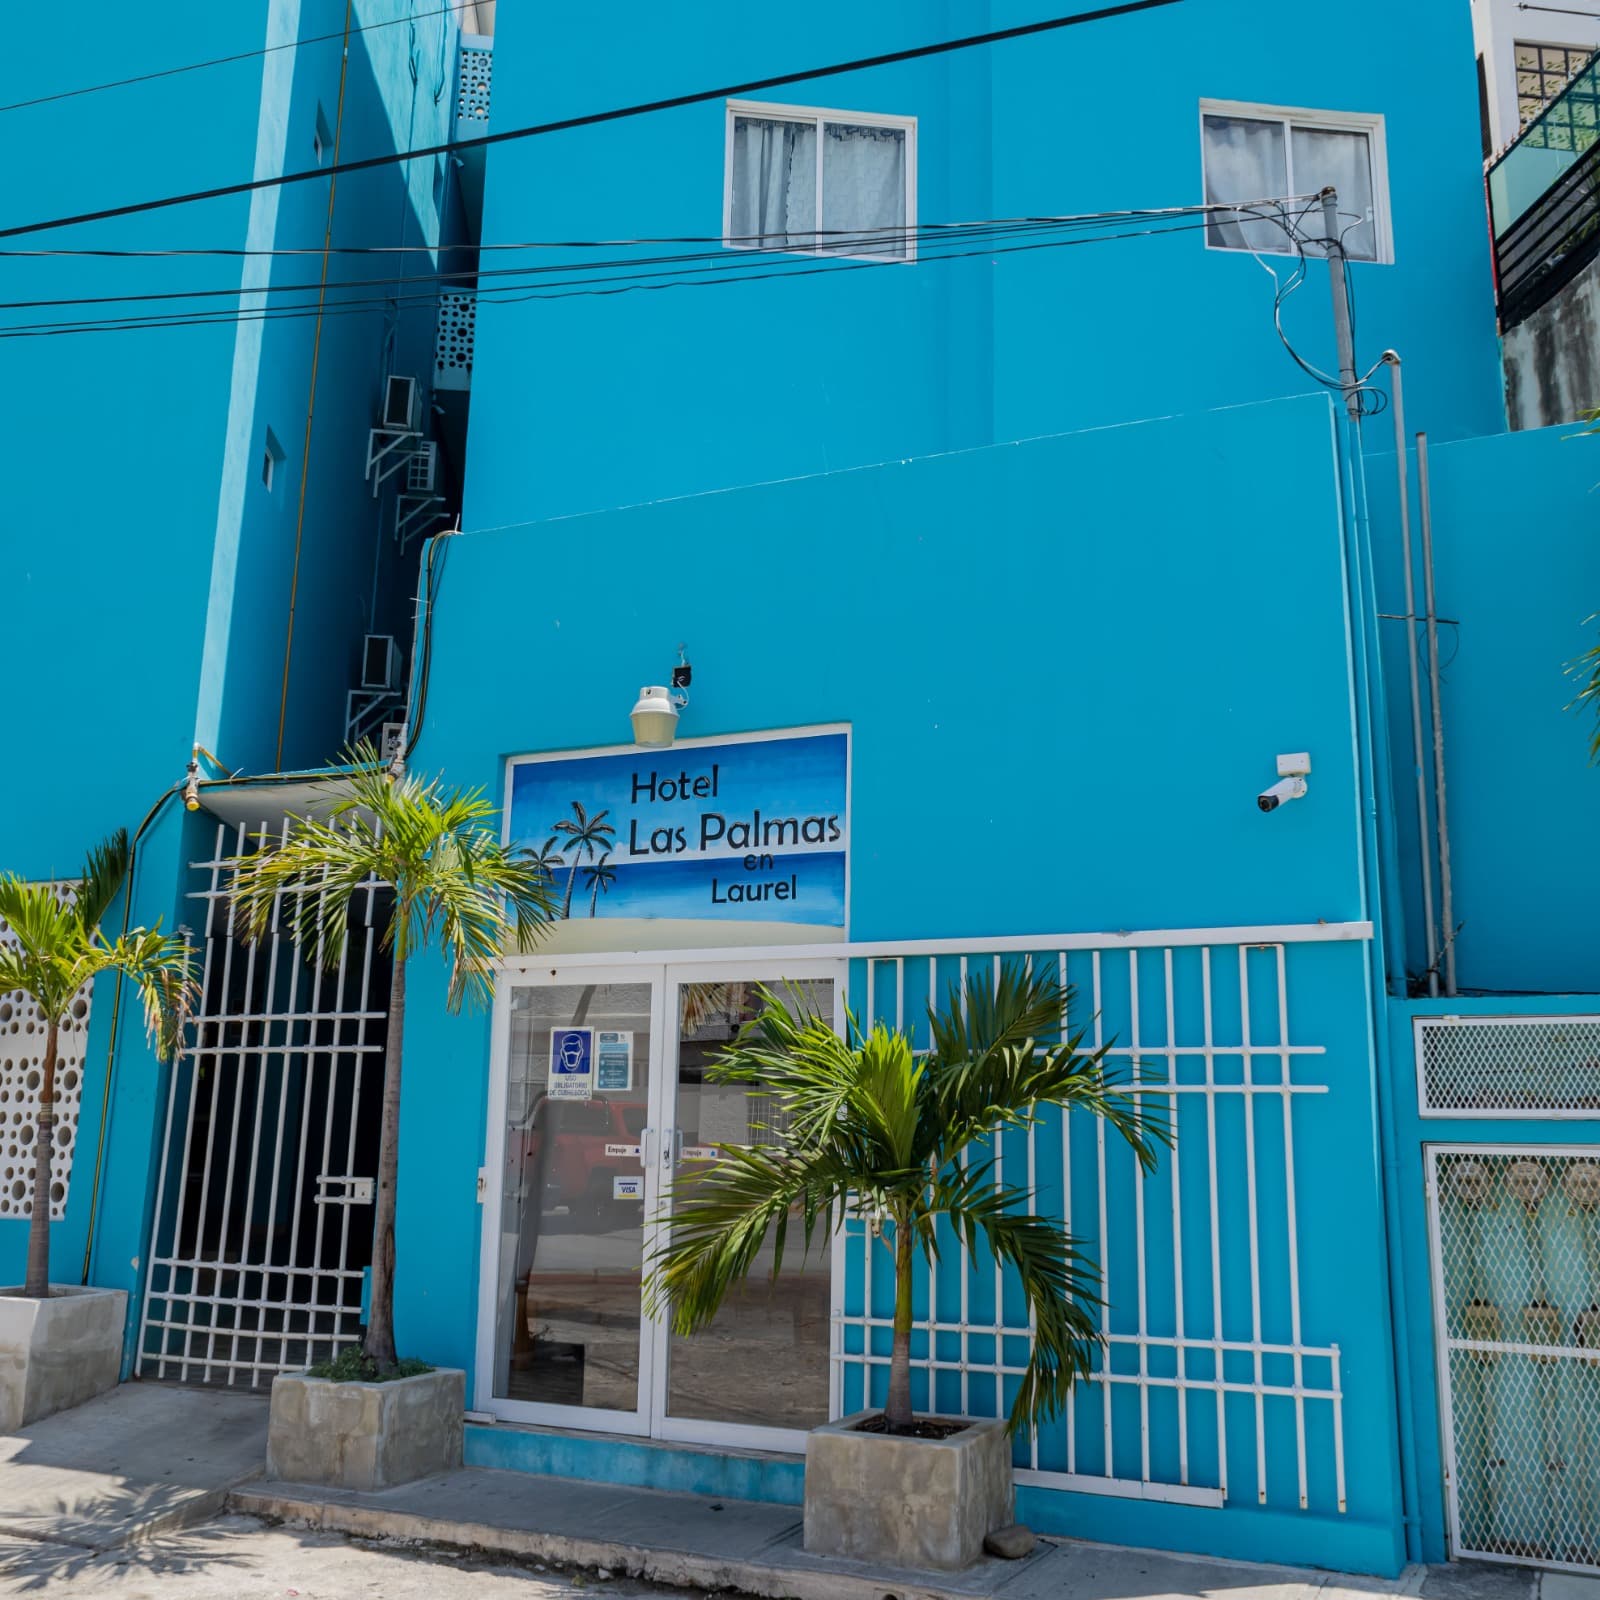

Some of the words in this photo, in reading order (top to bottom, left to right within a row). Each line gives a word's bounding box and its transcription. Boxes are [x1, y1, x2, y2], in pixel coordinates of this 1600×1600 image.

[631, 764, 719, 804] Hotel
[629, 819, 687, 856] Las
[700, 809, 841, 851] Palmas
[743, 853, 774, 871] en
[711, 874, 797, 904] Laurel
[607, 1145, 627, 1154] Empuje
